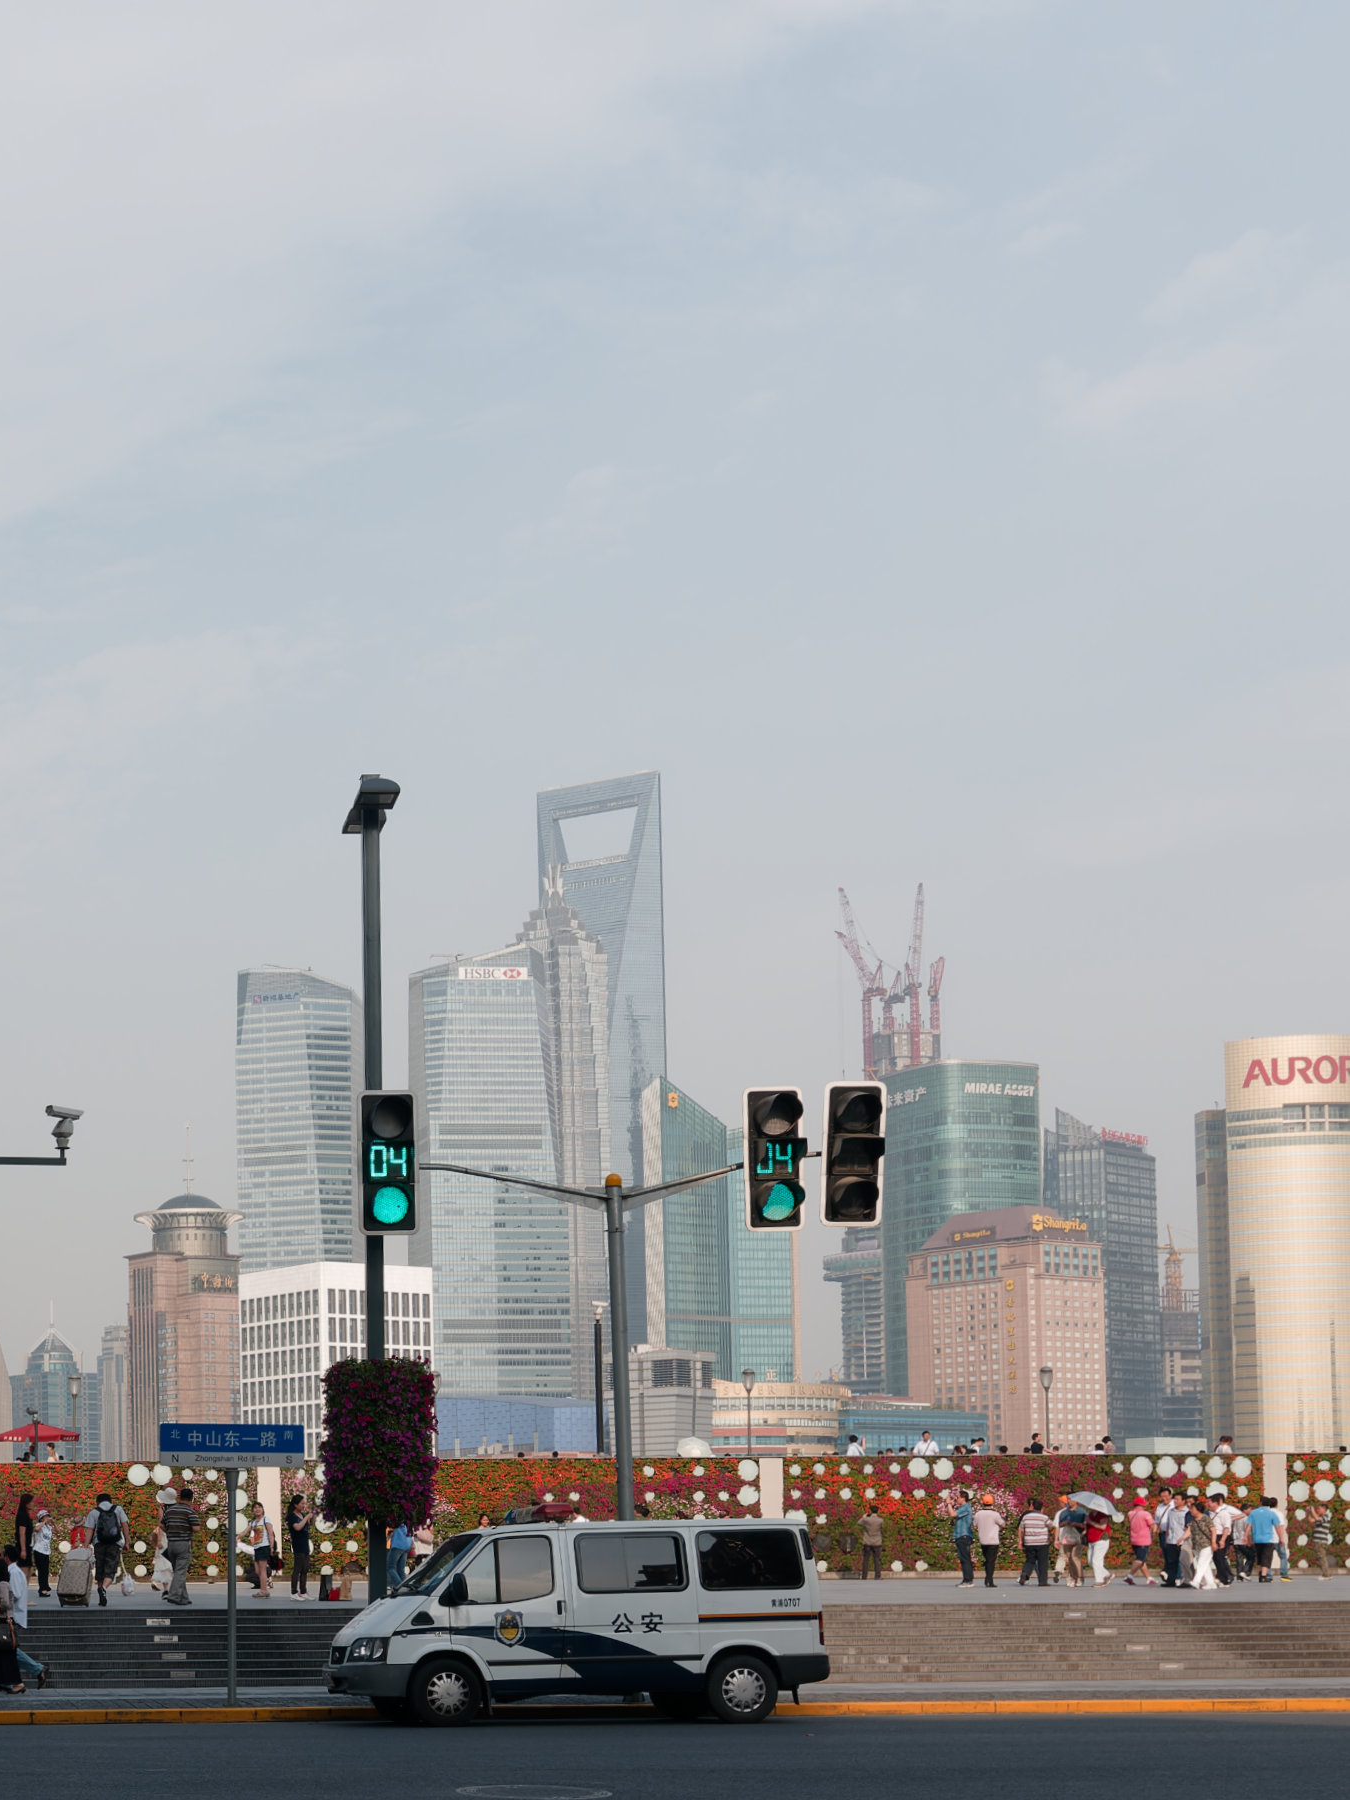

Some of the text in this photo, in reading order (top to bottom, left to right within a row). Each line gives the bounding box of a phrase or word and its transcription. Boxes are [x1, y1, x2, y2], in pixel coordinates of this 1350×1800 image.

[464, 968, 501, 979] HSBC
[964, 1082, 1035, 1097] MIRAE ASSET
[370, 1145, 407, 1178] 04
[723, 1387, 778, 1397] SUER
[170, 1428, 294, 1448] 北 中山东一路 南
[171, 1454, 180, 1463] N
[194, 1454, 235, 1464] Zhongshan
[237, 1454, 249, 1463] Rd
[285, 1455, 293, 1465] S
[611, 1612, 664, 1634] 公安
